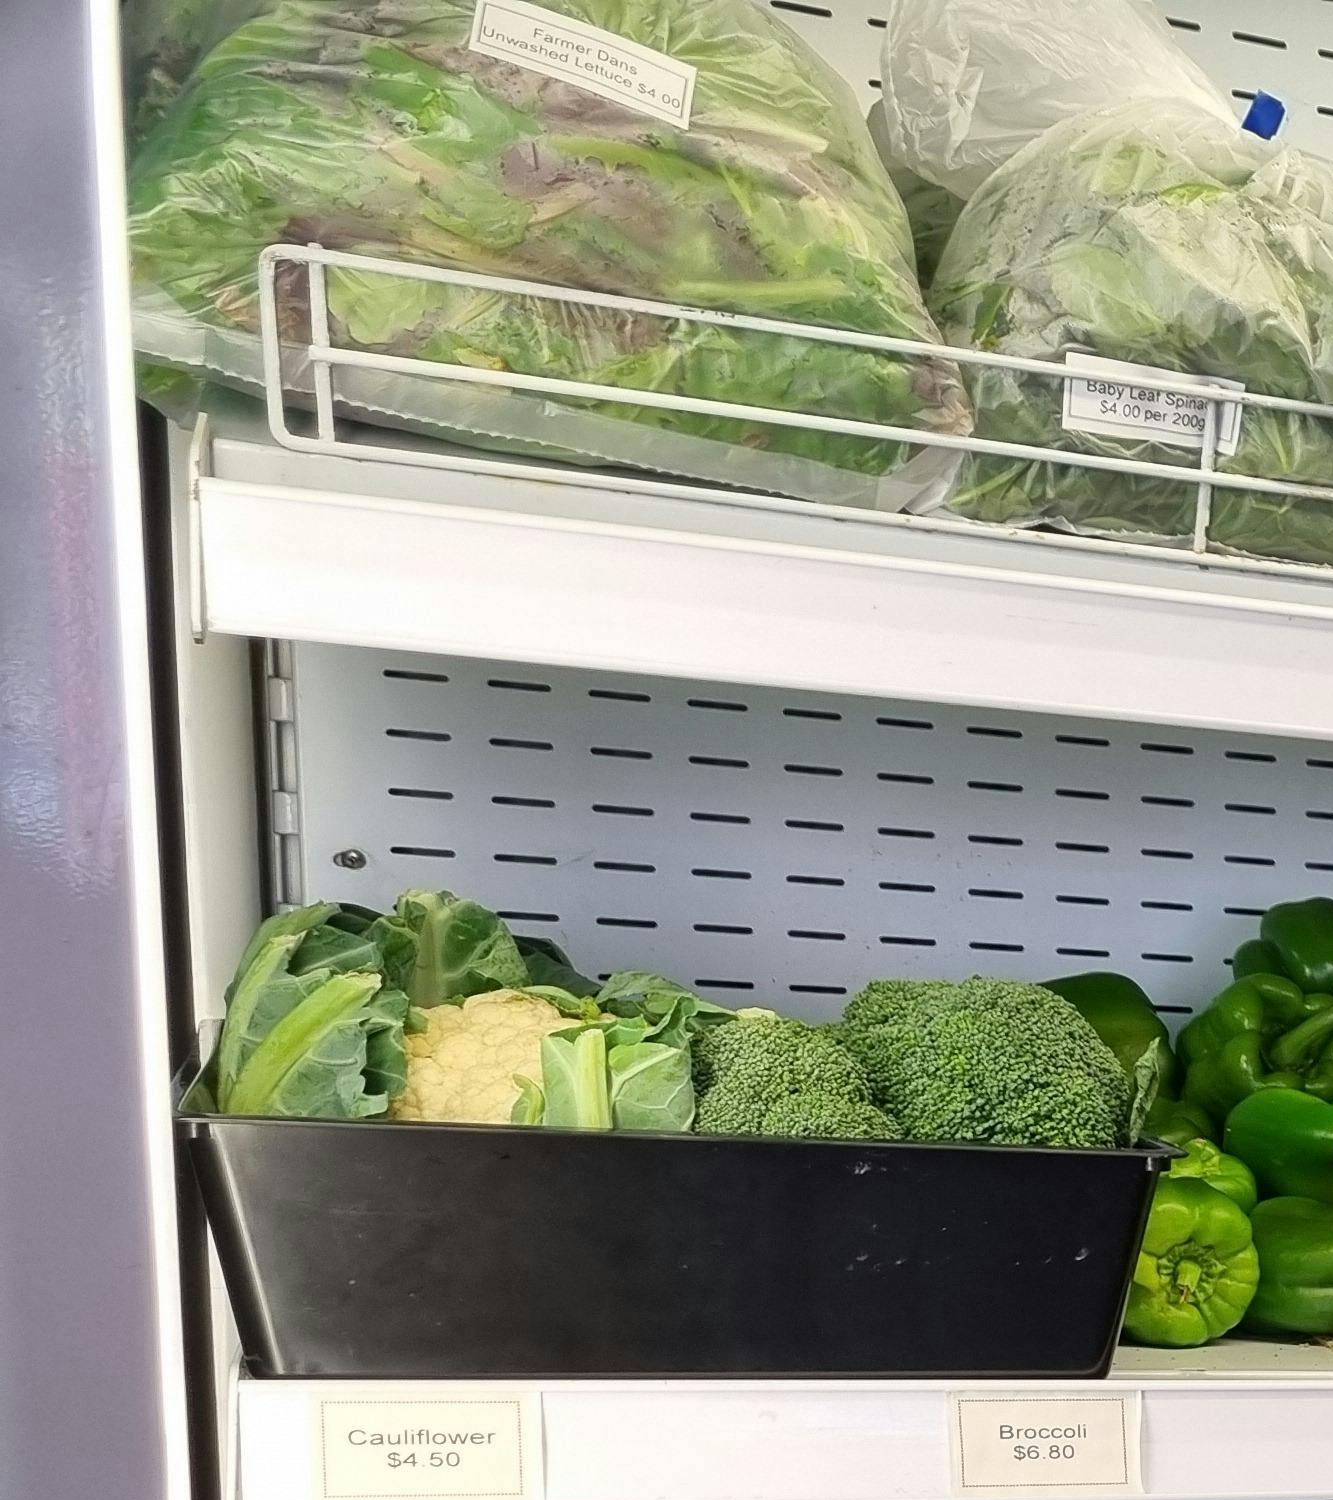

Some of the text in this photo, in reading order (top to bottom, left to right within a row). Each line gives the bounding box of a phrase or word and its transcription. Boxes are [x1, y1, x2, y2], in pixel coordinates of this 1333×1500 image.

[533, 28, 638, 76] Farmer Dans
[483, 26, 680, 108] Unwashed Lettuce $4.00
[1087, 380, 1208, 411] Baby Leaf Spina
[1100, 400, 1205, 431] $4.00 per 200g
[348, 1429, 496, 1446] Cauliflower
[999, 1424, 1087, 1439] Broccoli
[387, 1452, 461, 1469] $4.50
[1013, 1445, 1075, 1461] $6.80
